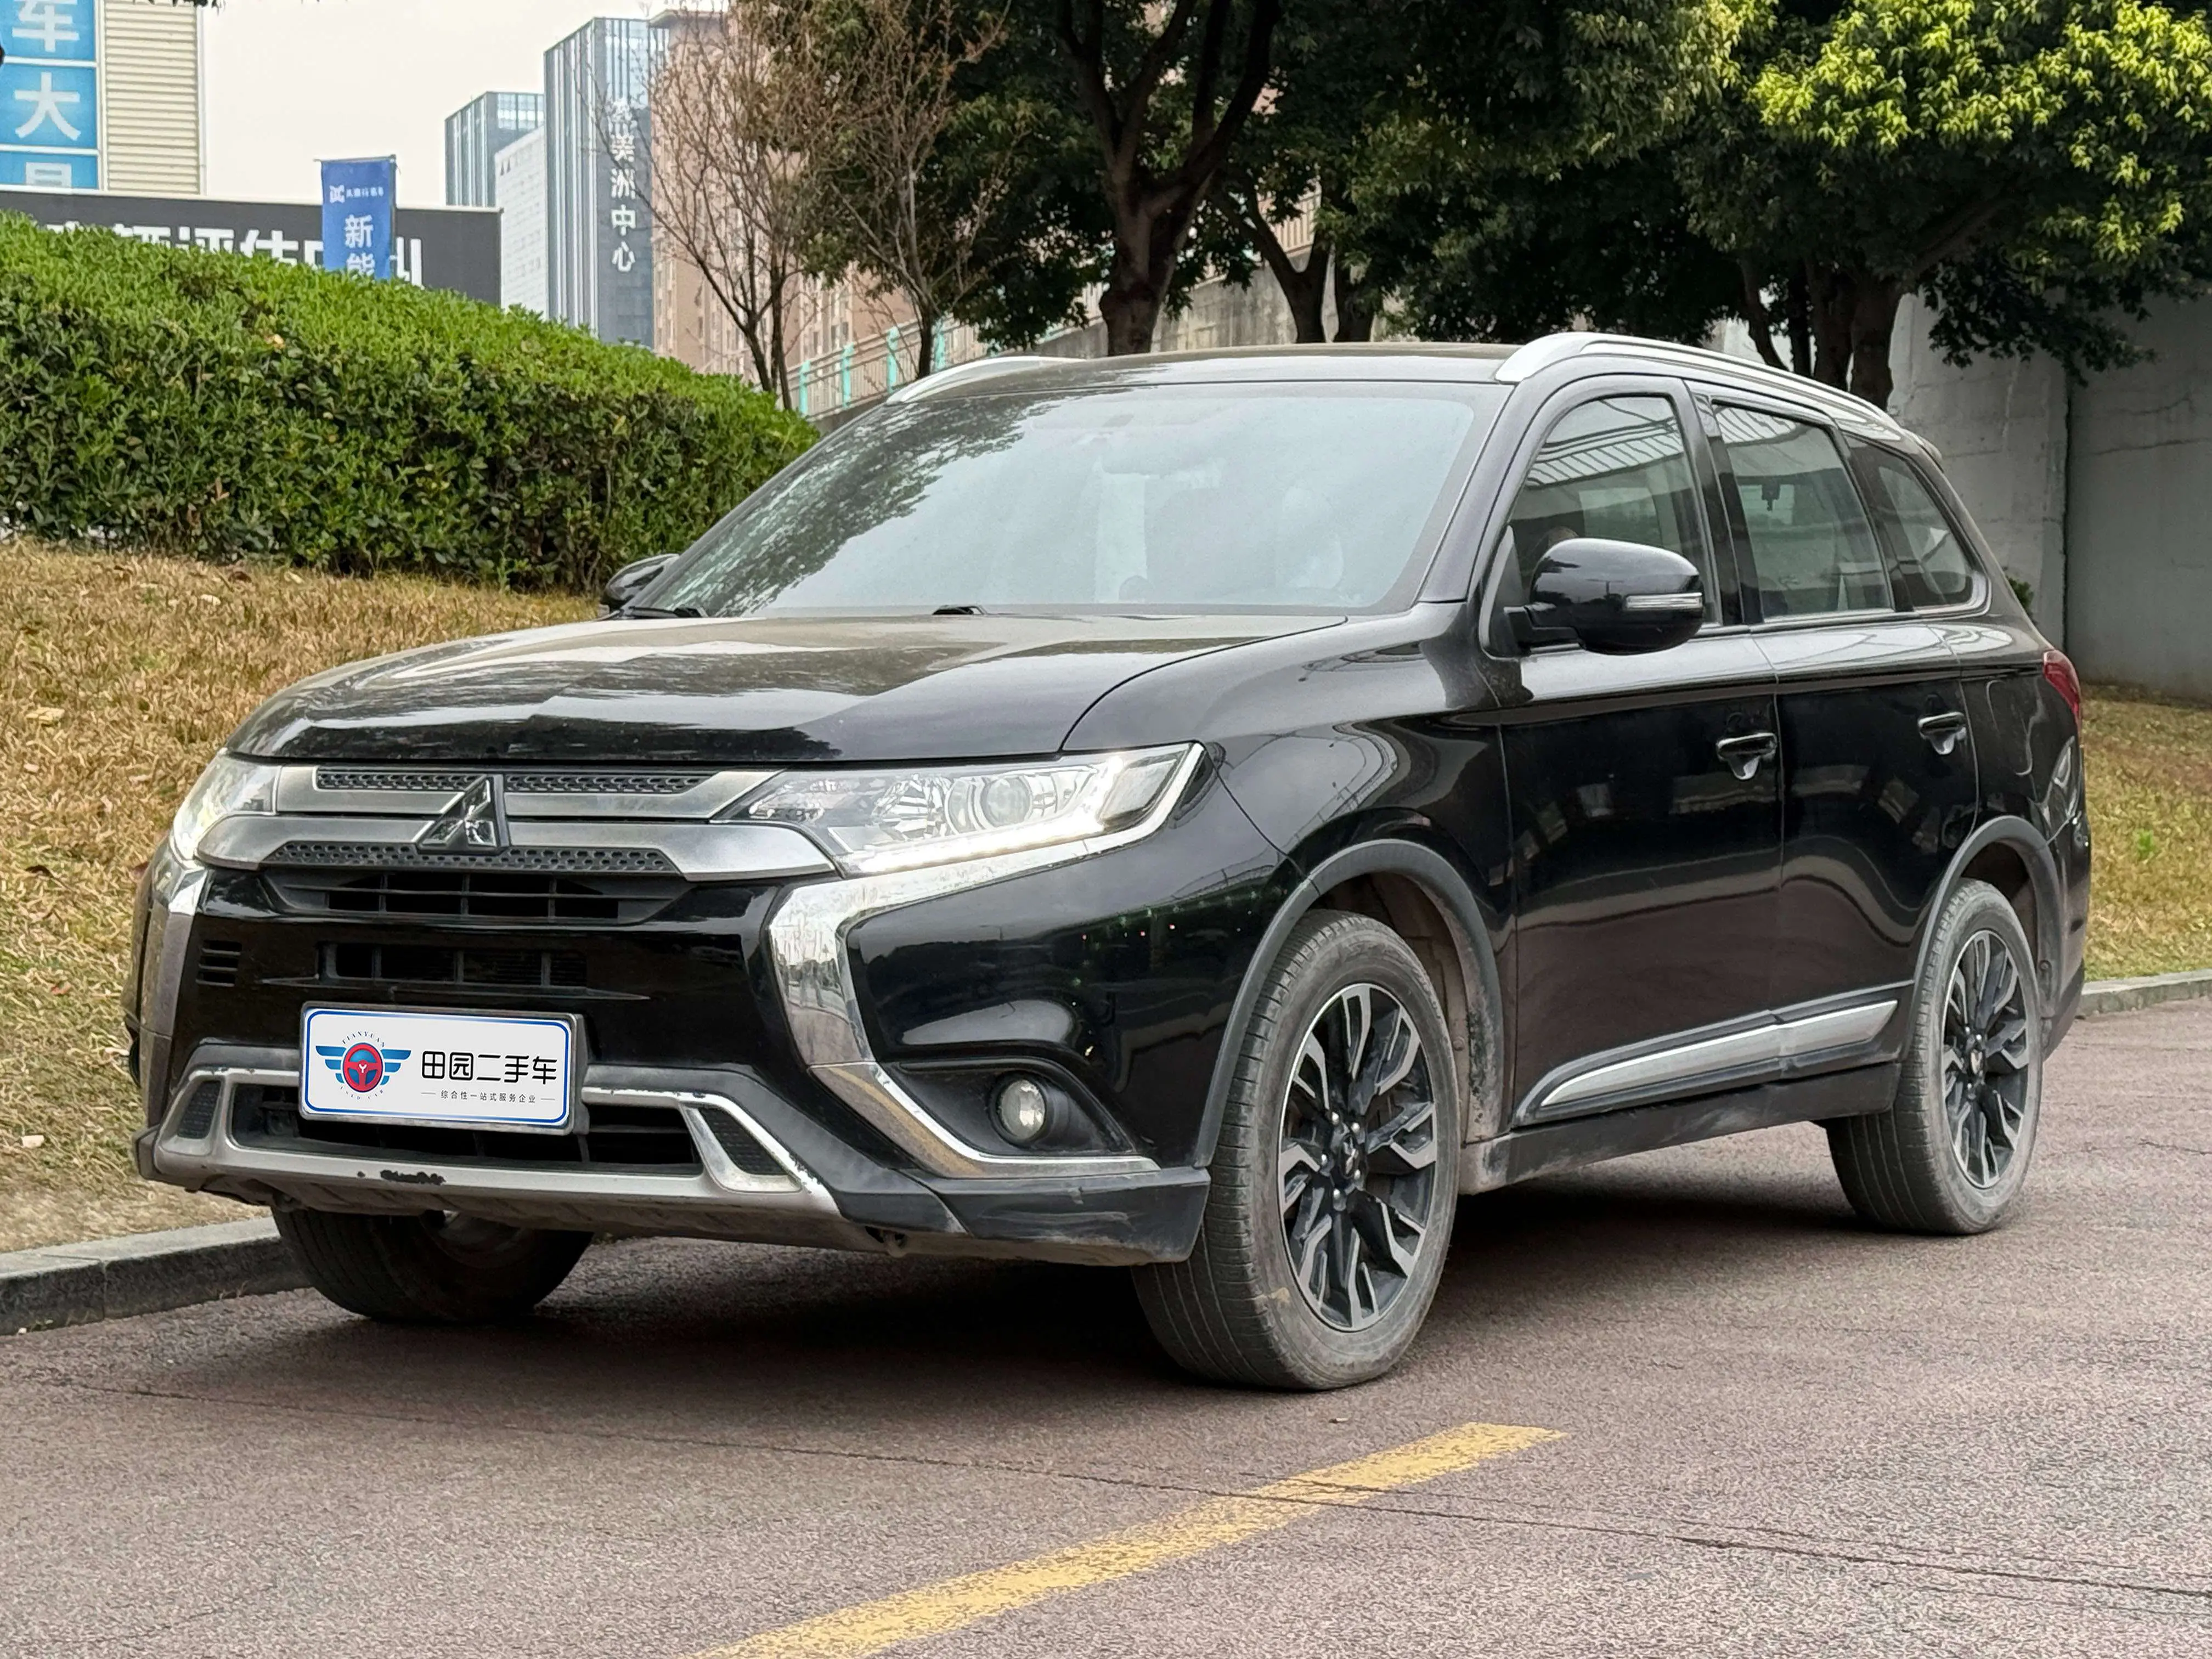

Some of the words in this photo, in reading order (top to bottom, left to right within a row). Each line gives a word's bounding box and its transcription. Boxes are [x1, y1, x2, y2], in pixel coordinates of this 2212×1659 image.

[342, 1031, 385, 1048] TIANYUAN
[421, 1051, 557, 1085] 田园二手车
[441, 1090, 536, 1103] 综合性一站式服务企业
